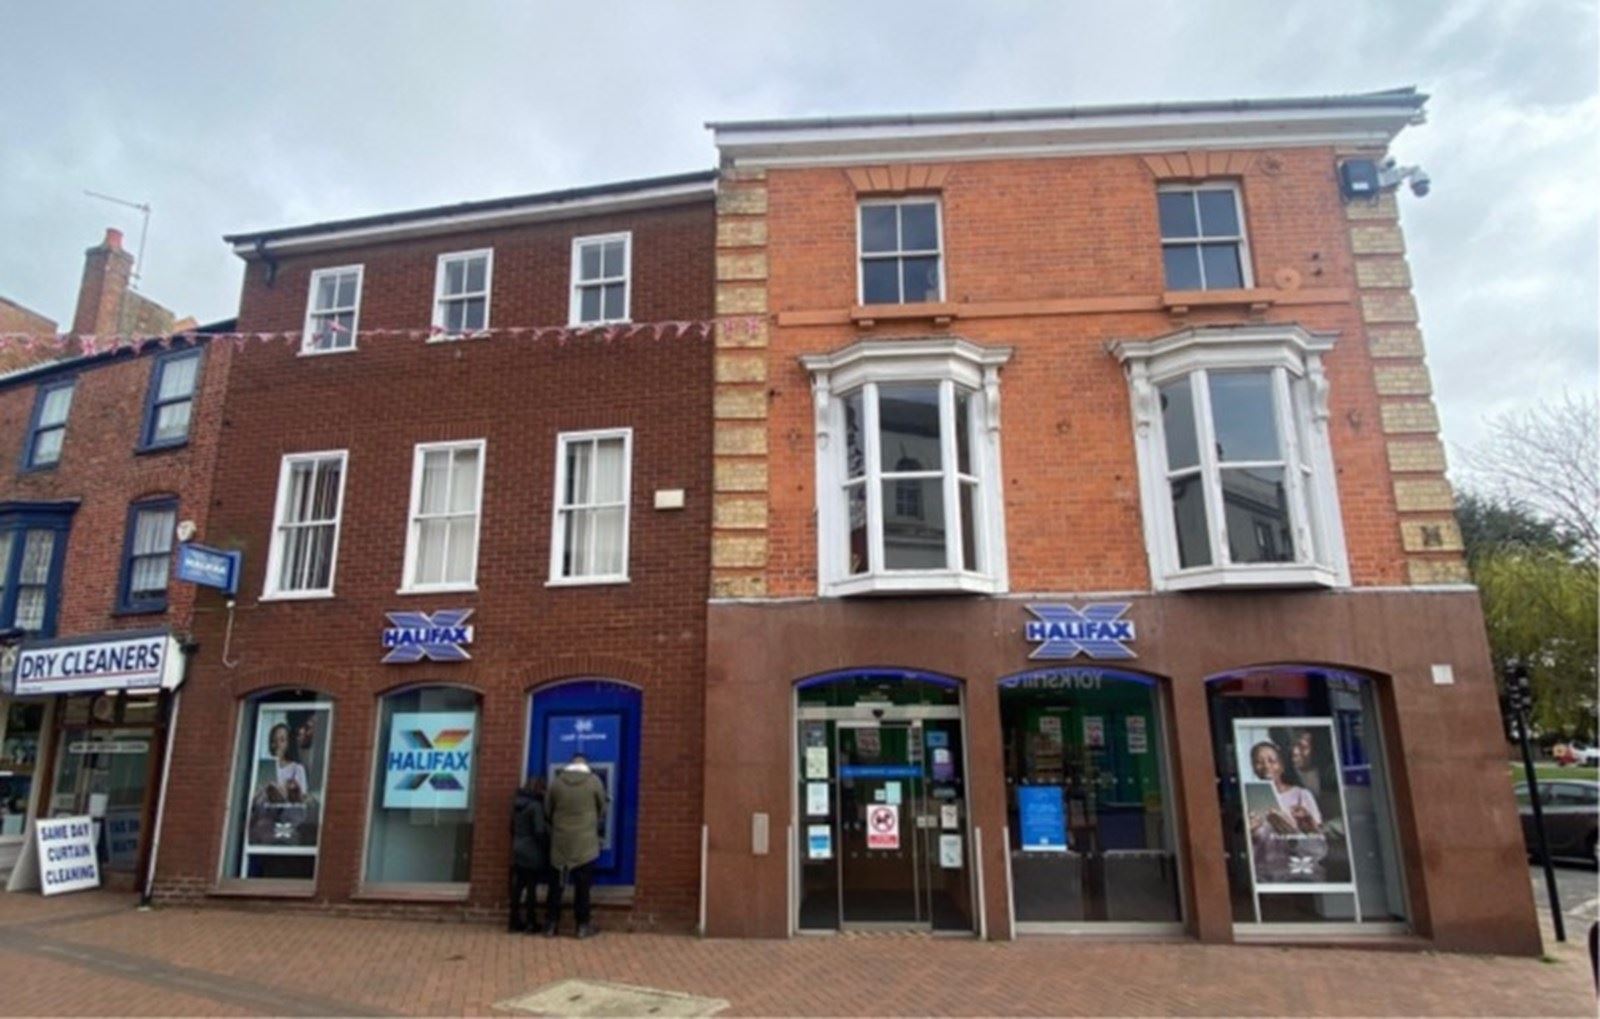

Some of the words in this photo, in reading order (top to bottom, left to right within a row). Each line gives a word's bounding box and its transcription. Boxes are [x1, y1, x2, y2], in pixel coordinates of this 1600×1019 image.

[384, 628, 468, 646] HALIFAX
[1028, 622, 1132, 639] HALIFAX
[21, 653, 58, 679] DRY
[61, 643, 161, 676] CLEANERS
[389, 751, 469, 771] HALIFAX
[42, 825, 68, 841] SAME
[70, 823, 89, 838] DAY
[47, 844, 91, 862] CURTAIN
[46, 864, 95, 885] CLEANING
